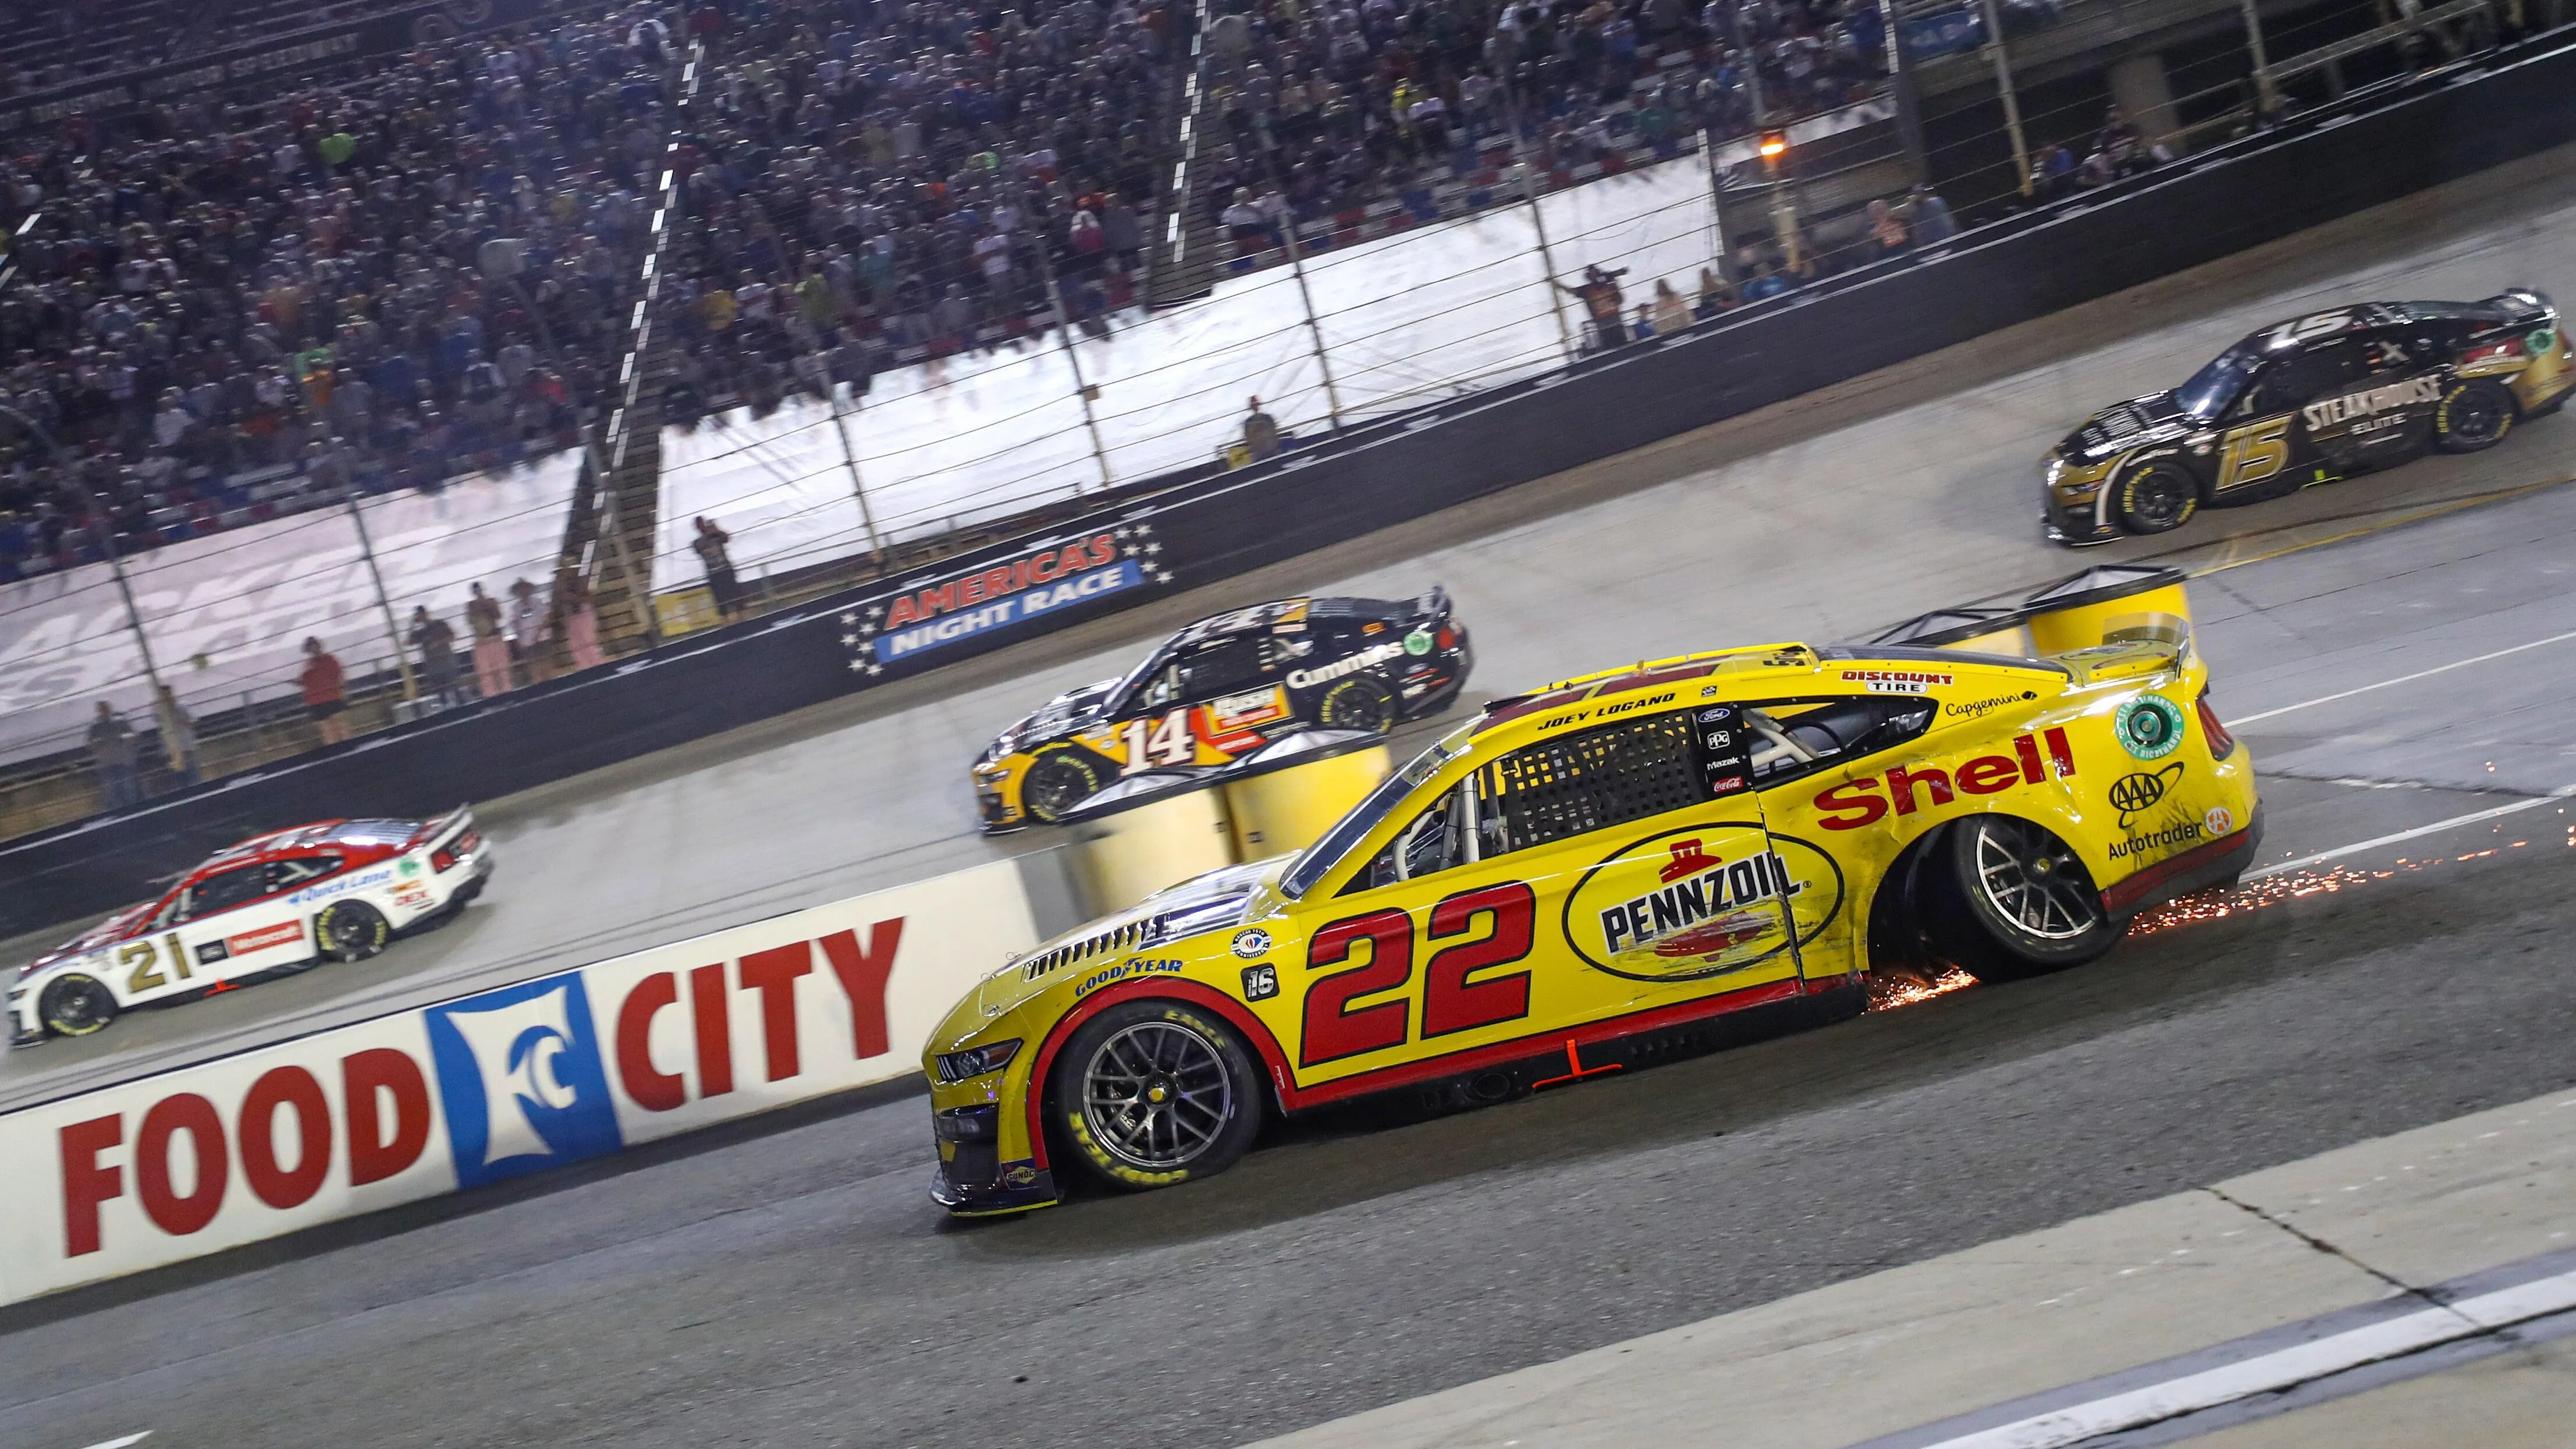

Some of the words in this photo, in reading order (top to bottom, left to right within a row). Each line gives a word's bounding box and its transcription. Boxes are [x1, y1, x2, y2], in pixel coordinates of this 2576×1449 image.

[2216, 415, 2293, 491] 15
[883, 533, 1116, 631] AMERICA'S
[890, 600, 1017, 656] NIGHT
[1021, 566, 1125, 615] RACE
[1286, 641, 1406, 690] Cummins
[1842, 671, 1953, 684] DISCOUNT
[1873, 683, 1920, 692] TIRE
[1946, 693, 2021, 717] Capgemini
[1537, 711, 1590, 730] JOEY
[1597, 693, 1676, 716] LOGANO
[1703, 709, 1725, 721] Ford
[1121, 705, 1195, 777] 14
[1709, 733, 1728, 747] PPG
[1707, 757, 1740, 771] Mazak
[1814, 726, 2077, 830] Shell
[2116, 775, 2160, 810] AAA
[2108, 822, 2202, 861] Autotrader
[1600, 851, 1801, 954] PENNZOIL
[119, 932, 193, 994] 21
[1075, 957, 1183, 997] GOODYEAR
[1250, 967, 1274, 996] 16
[1298, 879, 1537, 1070] 22
[60, 1046, 431, 1259] FOOD
[617, 917, 905, 1112] CITY
